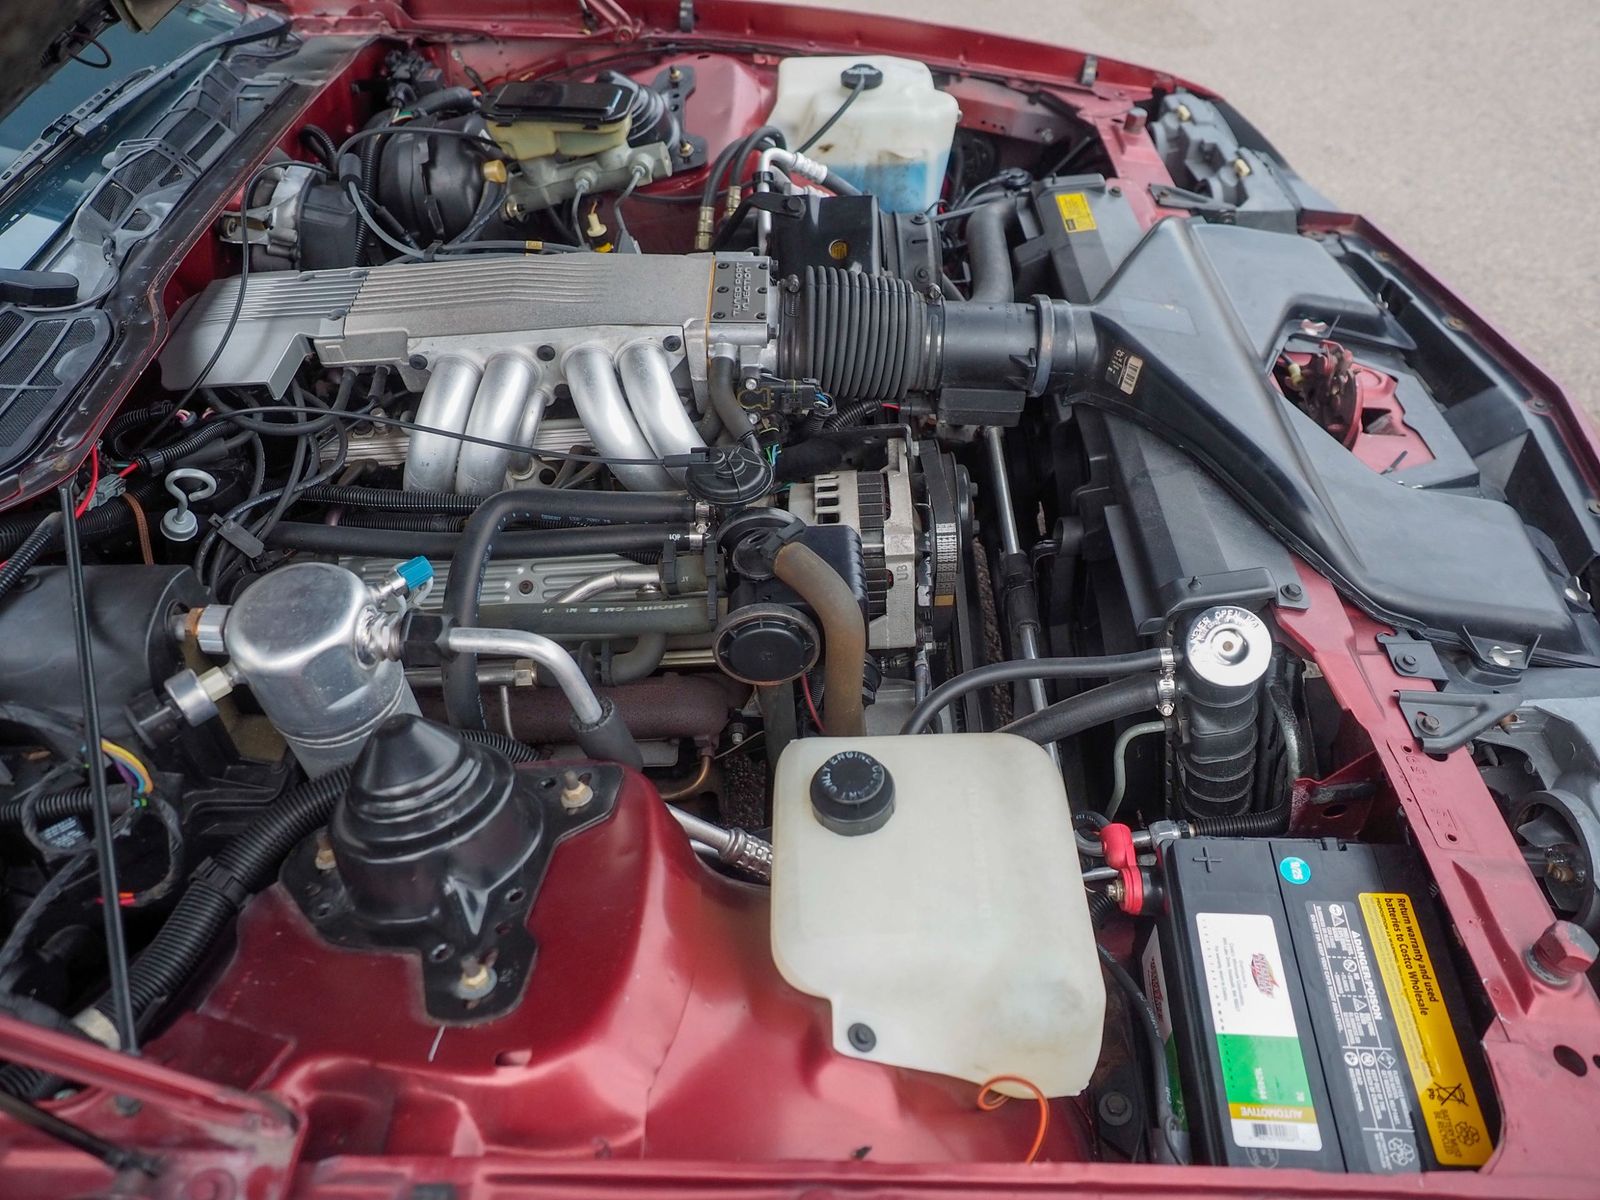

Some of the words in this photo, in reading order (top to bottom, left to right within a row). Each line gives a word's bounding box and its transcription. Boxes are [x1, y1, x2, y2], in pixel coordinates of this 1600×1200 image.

[733, 286, 742, 317] TUNED
[742, 267, 751, 311] INJECTION
[1214, 609, 1241, 620] OPEN
[830, 751, 873, 765] ENGINE
[821, 766, 838, 793] ONLY
[1385, 898, 1400, 932] batteries
[1396, 898, 1411, 925] Return
[1396, 933, 1404, 942] to
[1406, 925, 1423, 962] warranty
[1399, 943, 1412, 970] Costco
[1418, 962, 1432, 980] and
[1408, 970, 1429, 1016] Wholesale
[1424, 982, 1439, 1002] used
[1427, 1088, 1435, 1100] Pb
[1240, 1106, 1303, 1118] AUTOMOTIVE
